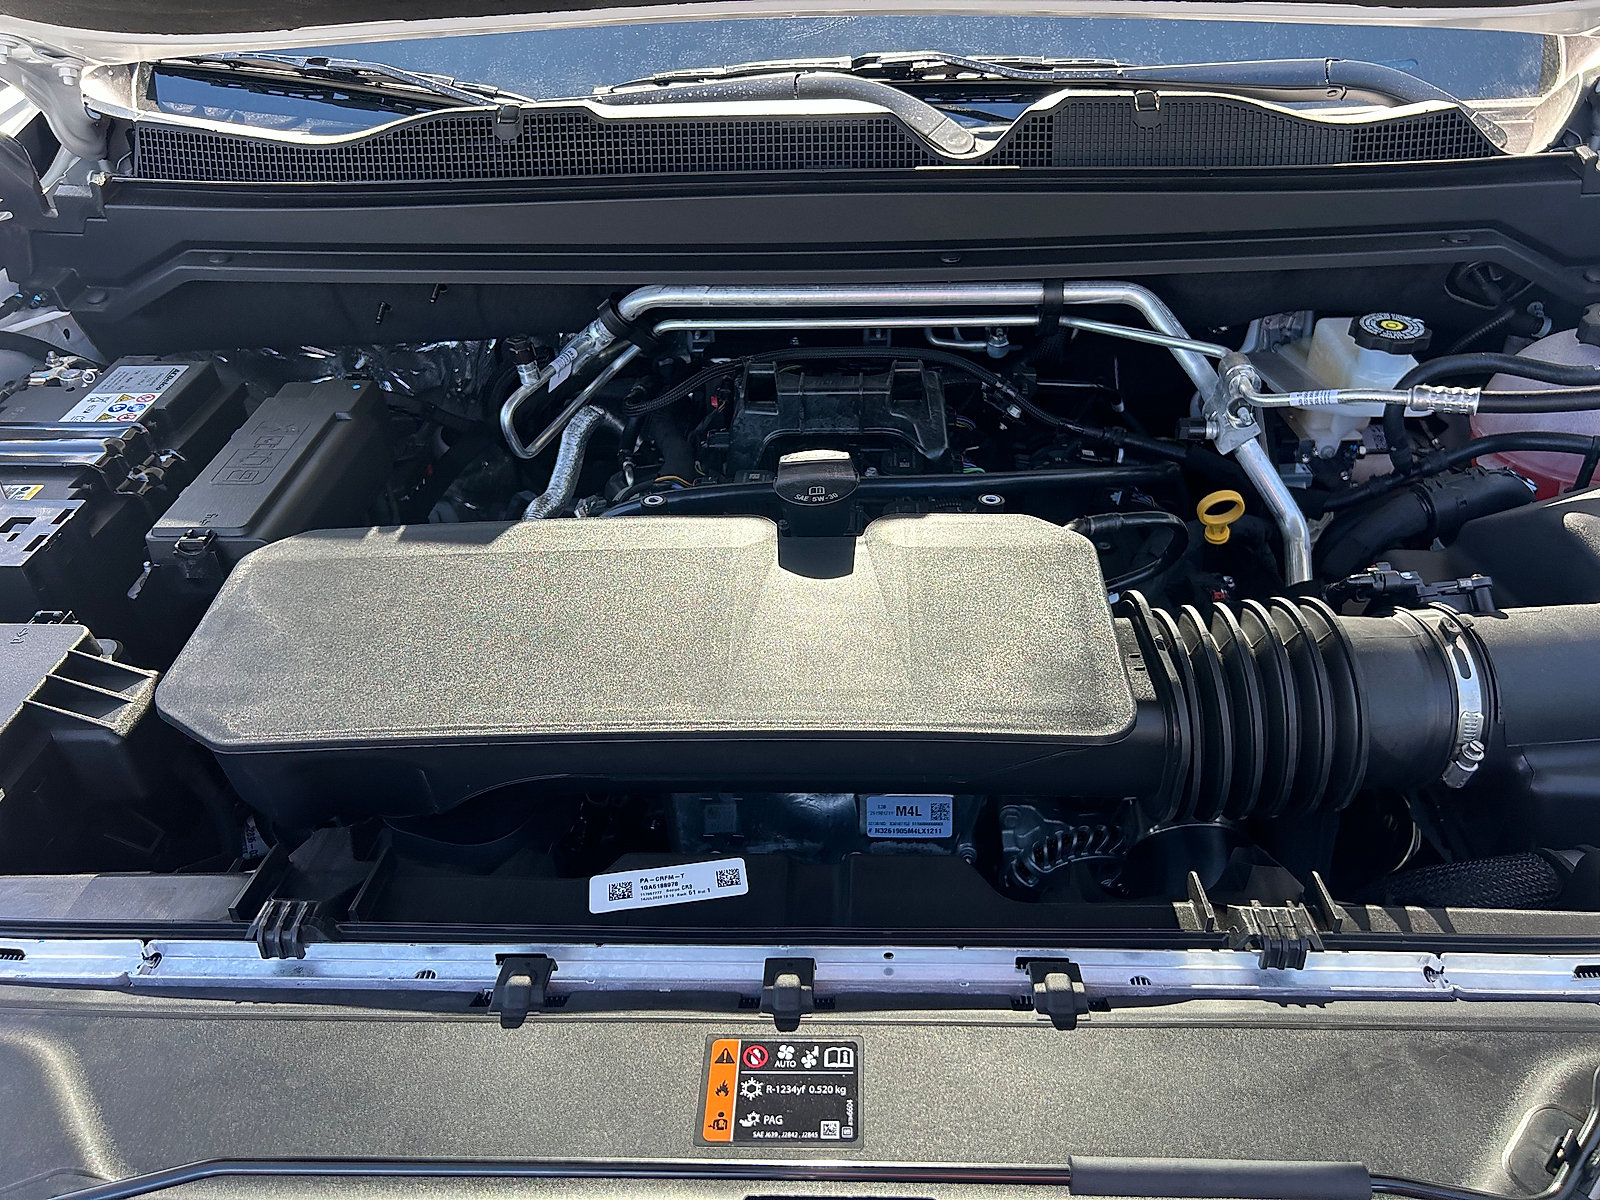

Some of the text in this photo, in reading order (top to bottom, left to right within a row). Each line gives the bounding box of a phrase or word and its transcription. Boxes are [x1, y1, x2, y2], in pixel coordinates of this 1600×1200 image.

[812, 493, 838, 502] 5W-30
[895, 805, 922, 817] M4L
[774, 1060, 797, 1069] AUTO
[766, 1084, 847, 1096] R-1234yf 0.520 kg
[763, 1114, 784, 1125] PAG
[752, 1131, 764, 1139] SAE
